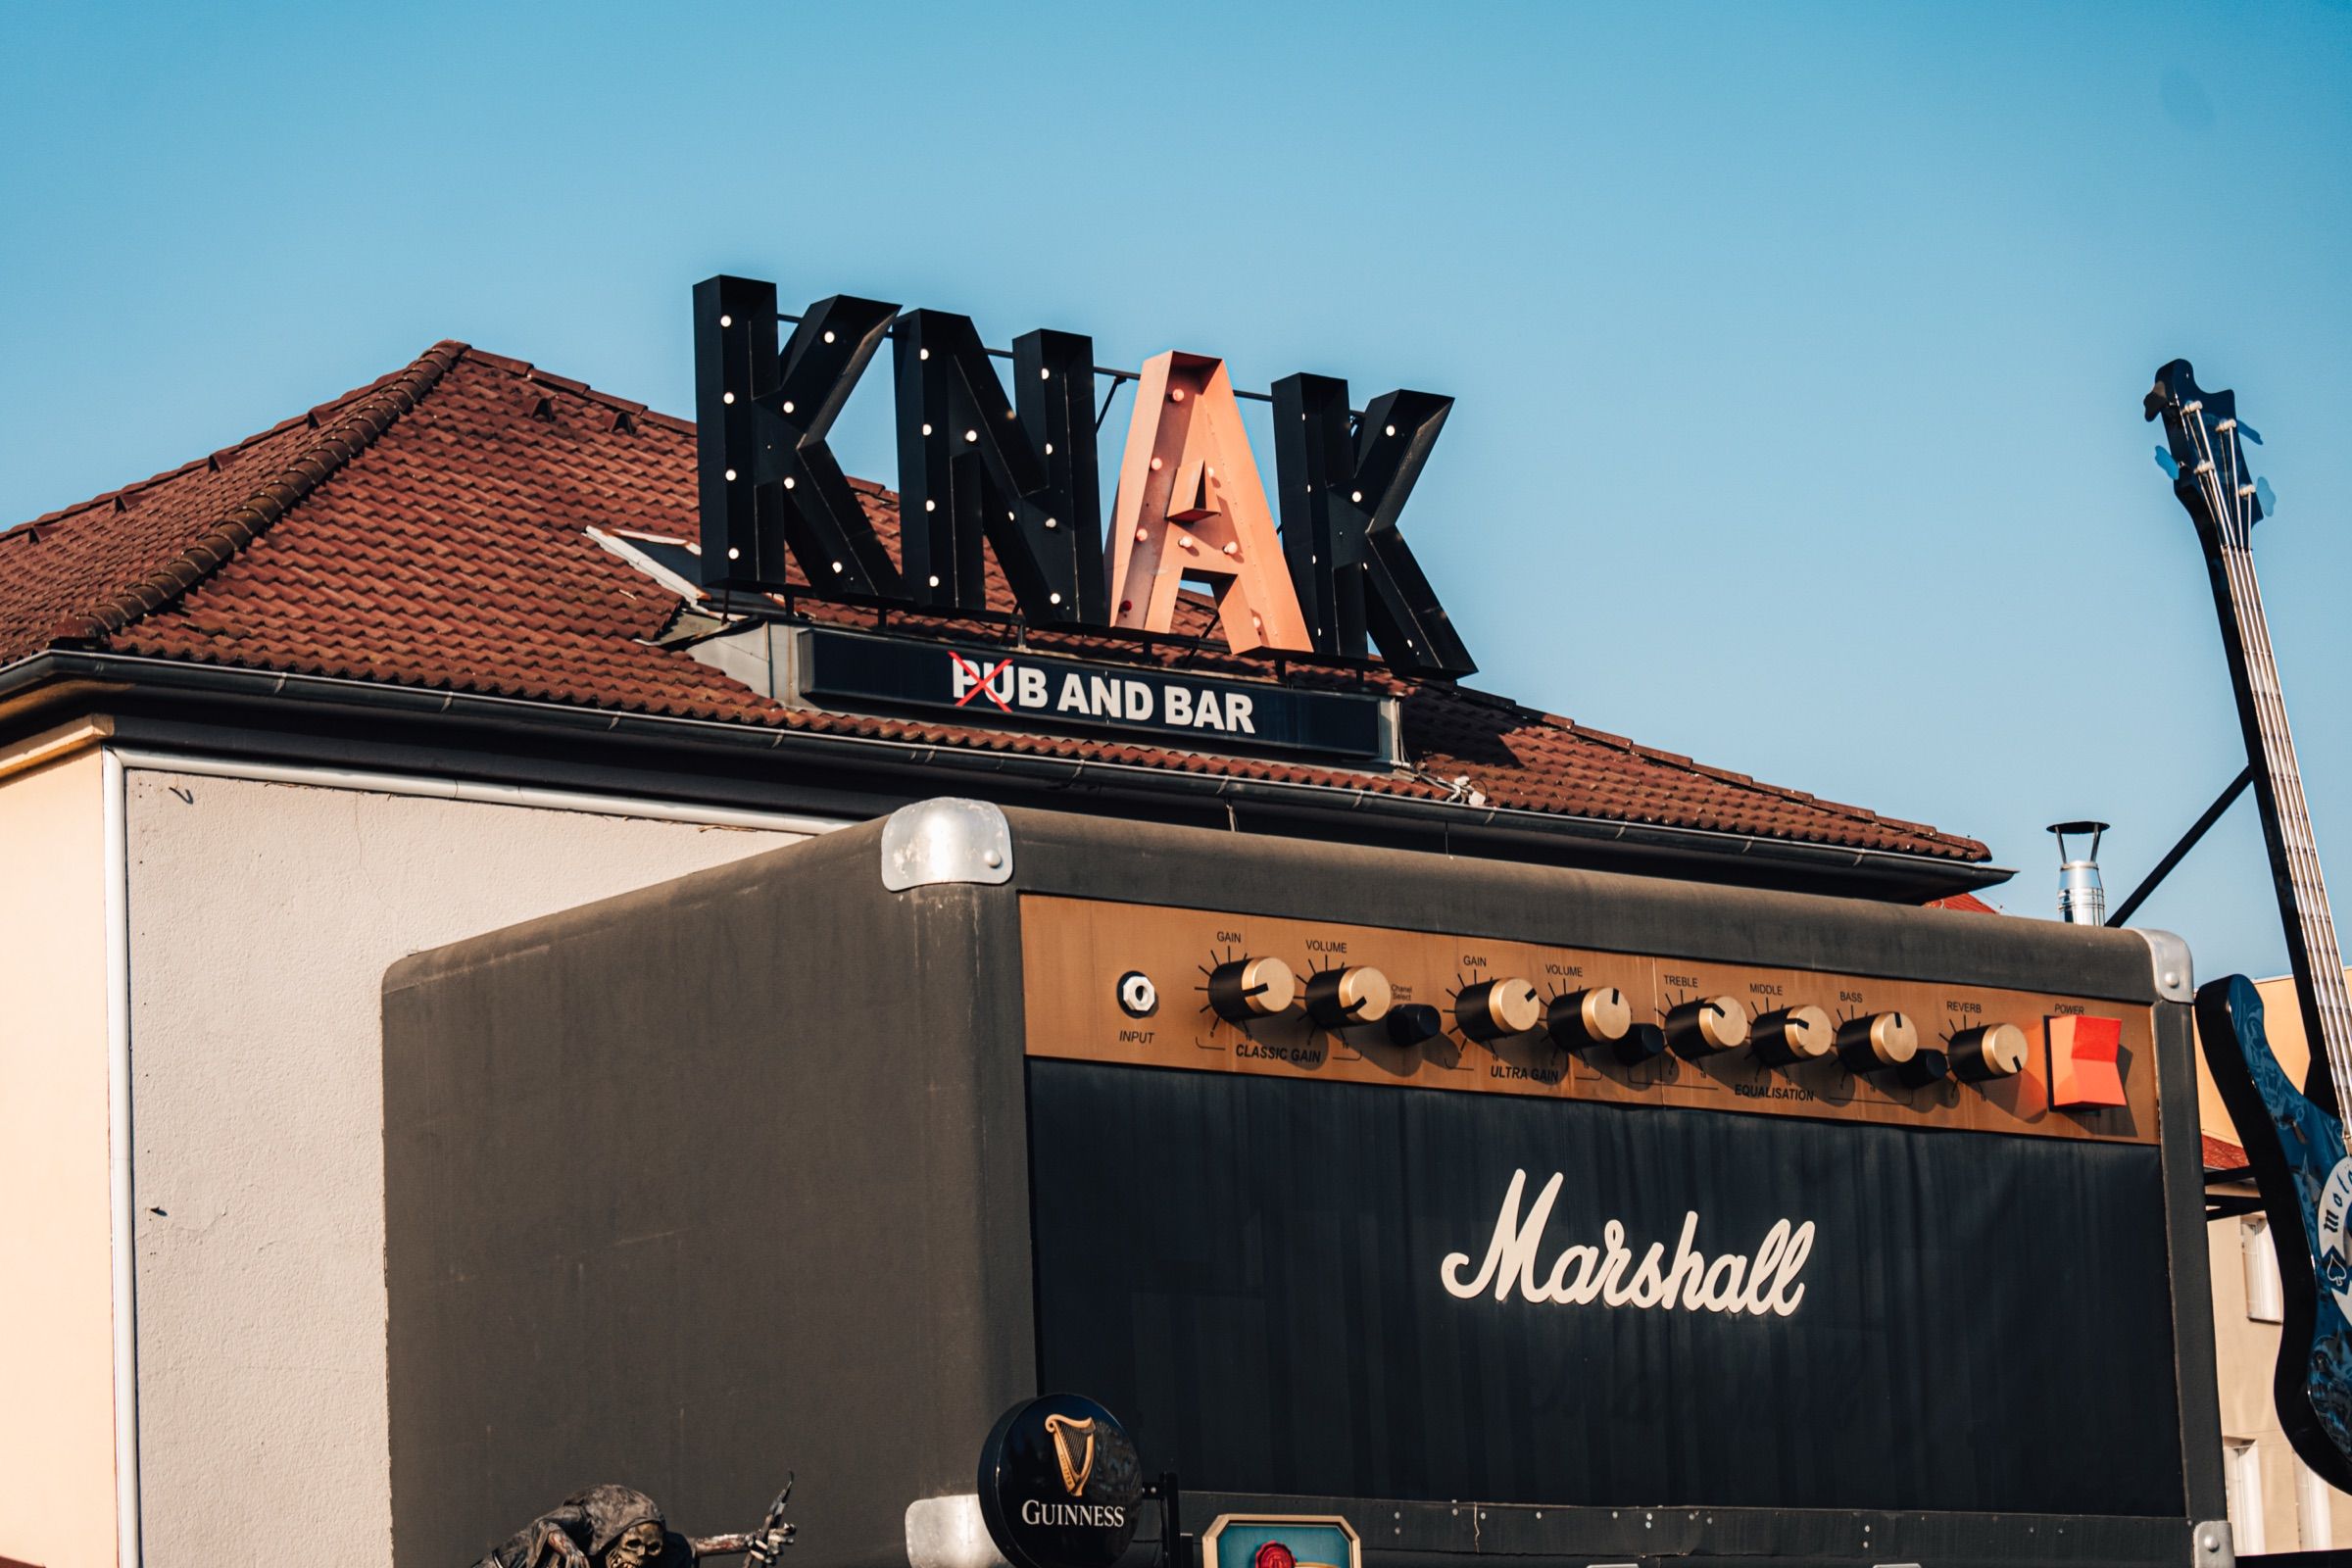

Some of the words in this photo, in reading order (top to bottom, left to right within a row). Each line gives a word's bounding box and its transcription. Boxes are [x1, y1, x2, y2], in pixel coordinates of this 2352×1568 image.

[693, 274, 1479, 680] KNAK
[952, 658, 1049, 709] PUB
[1056, 672, 1154, 720] AND
[1164, 684, 1255, 734] BAR
[1216, 931, 1242, 944] GAIN
[1305, 940, 1348, 954] VOLUME
[1463, 955, 1487, 967] GAIN
[1545, 964, 1583, 978] VOLUME
[1663, 974, 1698, 989] TREBLE
[1749, 983, 1784, 997] MIDDLE
[1839, 991, 1863, 1004] BASS
[1946, 1001, 1983, 1014] REVERB
[2054, 1003, 2085, 1016] POWER
[1118, 1029, 1155, 1044] INPUT
[1236, 1044, 1288, 1060] CLASSIC
[1291, 1048, 1321, 1063] GAIN
[1490, 1064, 1528, 1080] ULTRA
[1531, 1067, 1559, 1083] GAIN
[1734, 1083, 1815, 1102] EQUALISATION
[1440, 1167, 1816, 1318] Marshall
[1021, 1498, 1125, 1528] GUINNESS
